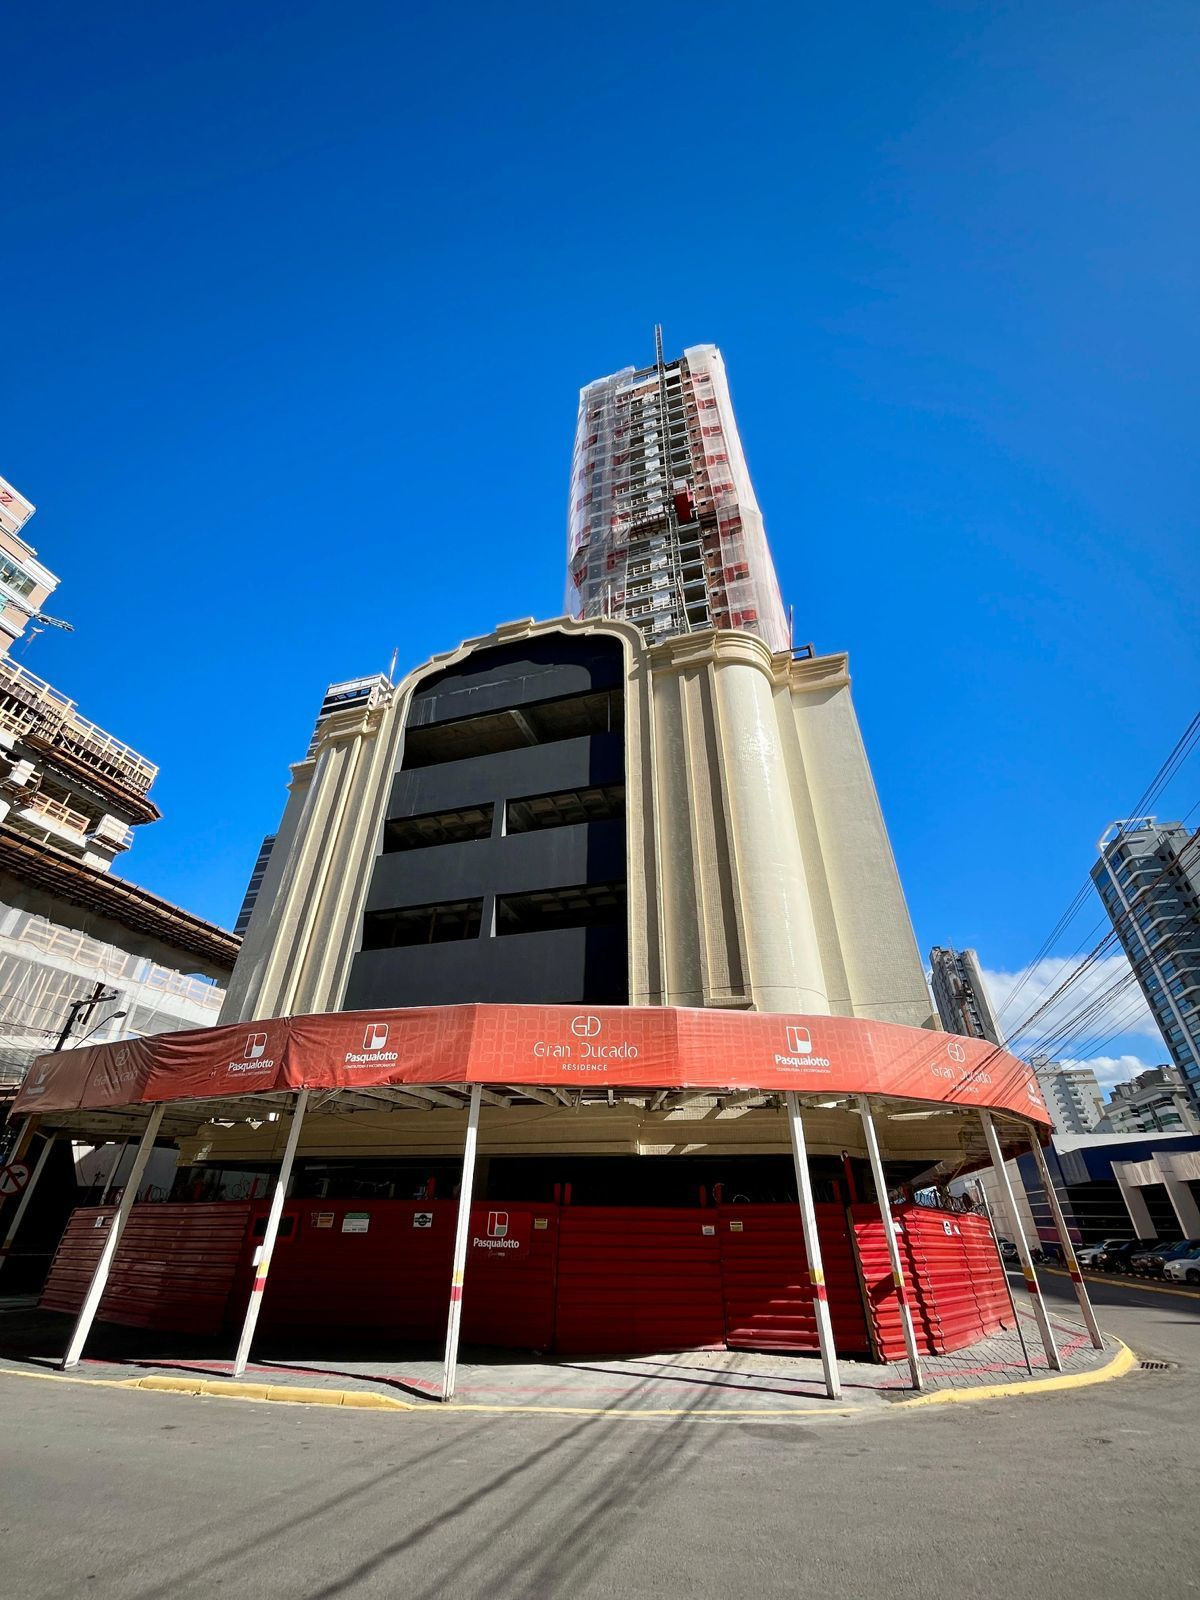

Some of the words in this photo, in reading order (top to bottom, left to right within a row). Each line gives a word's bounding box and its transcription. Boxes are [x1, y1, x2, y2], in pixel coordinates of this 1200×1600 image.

[533, 1041, 571, 1057] Gran
[345, 1050, 398, 1064] Pasqualotto
[774, 1054, 831, 1068] Pasqualotto
[227, 1059, 274, 1073] Pasqualotto
[562, 1063, 608, 1071] RESIDENCE
[473, 1237, 520, 1250] Pasqualotto
